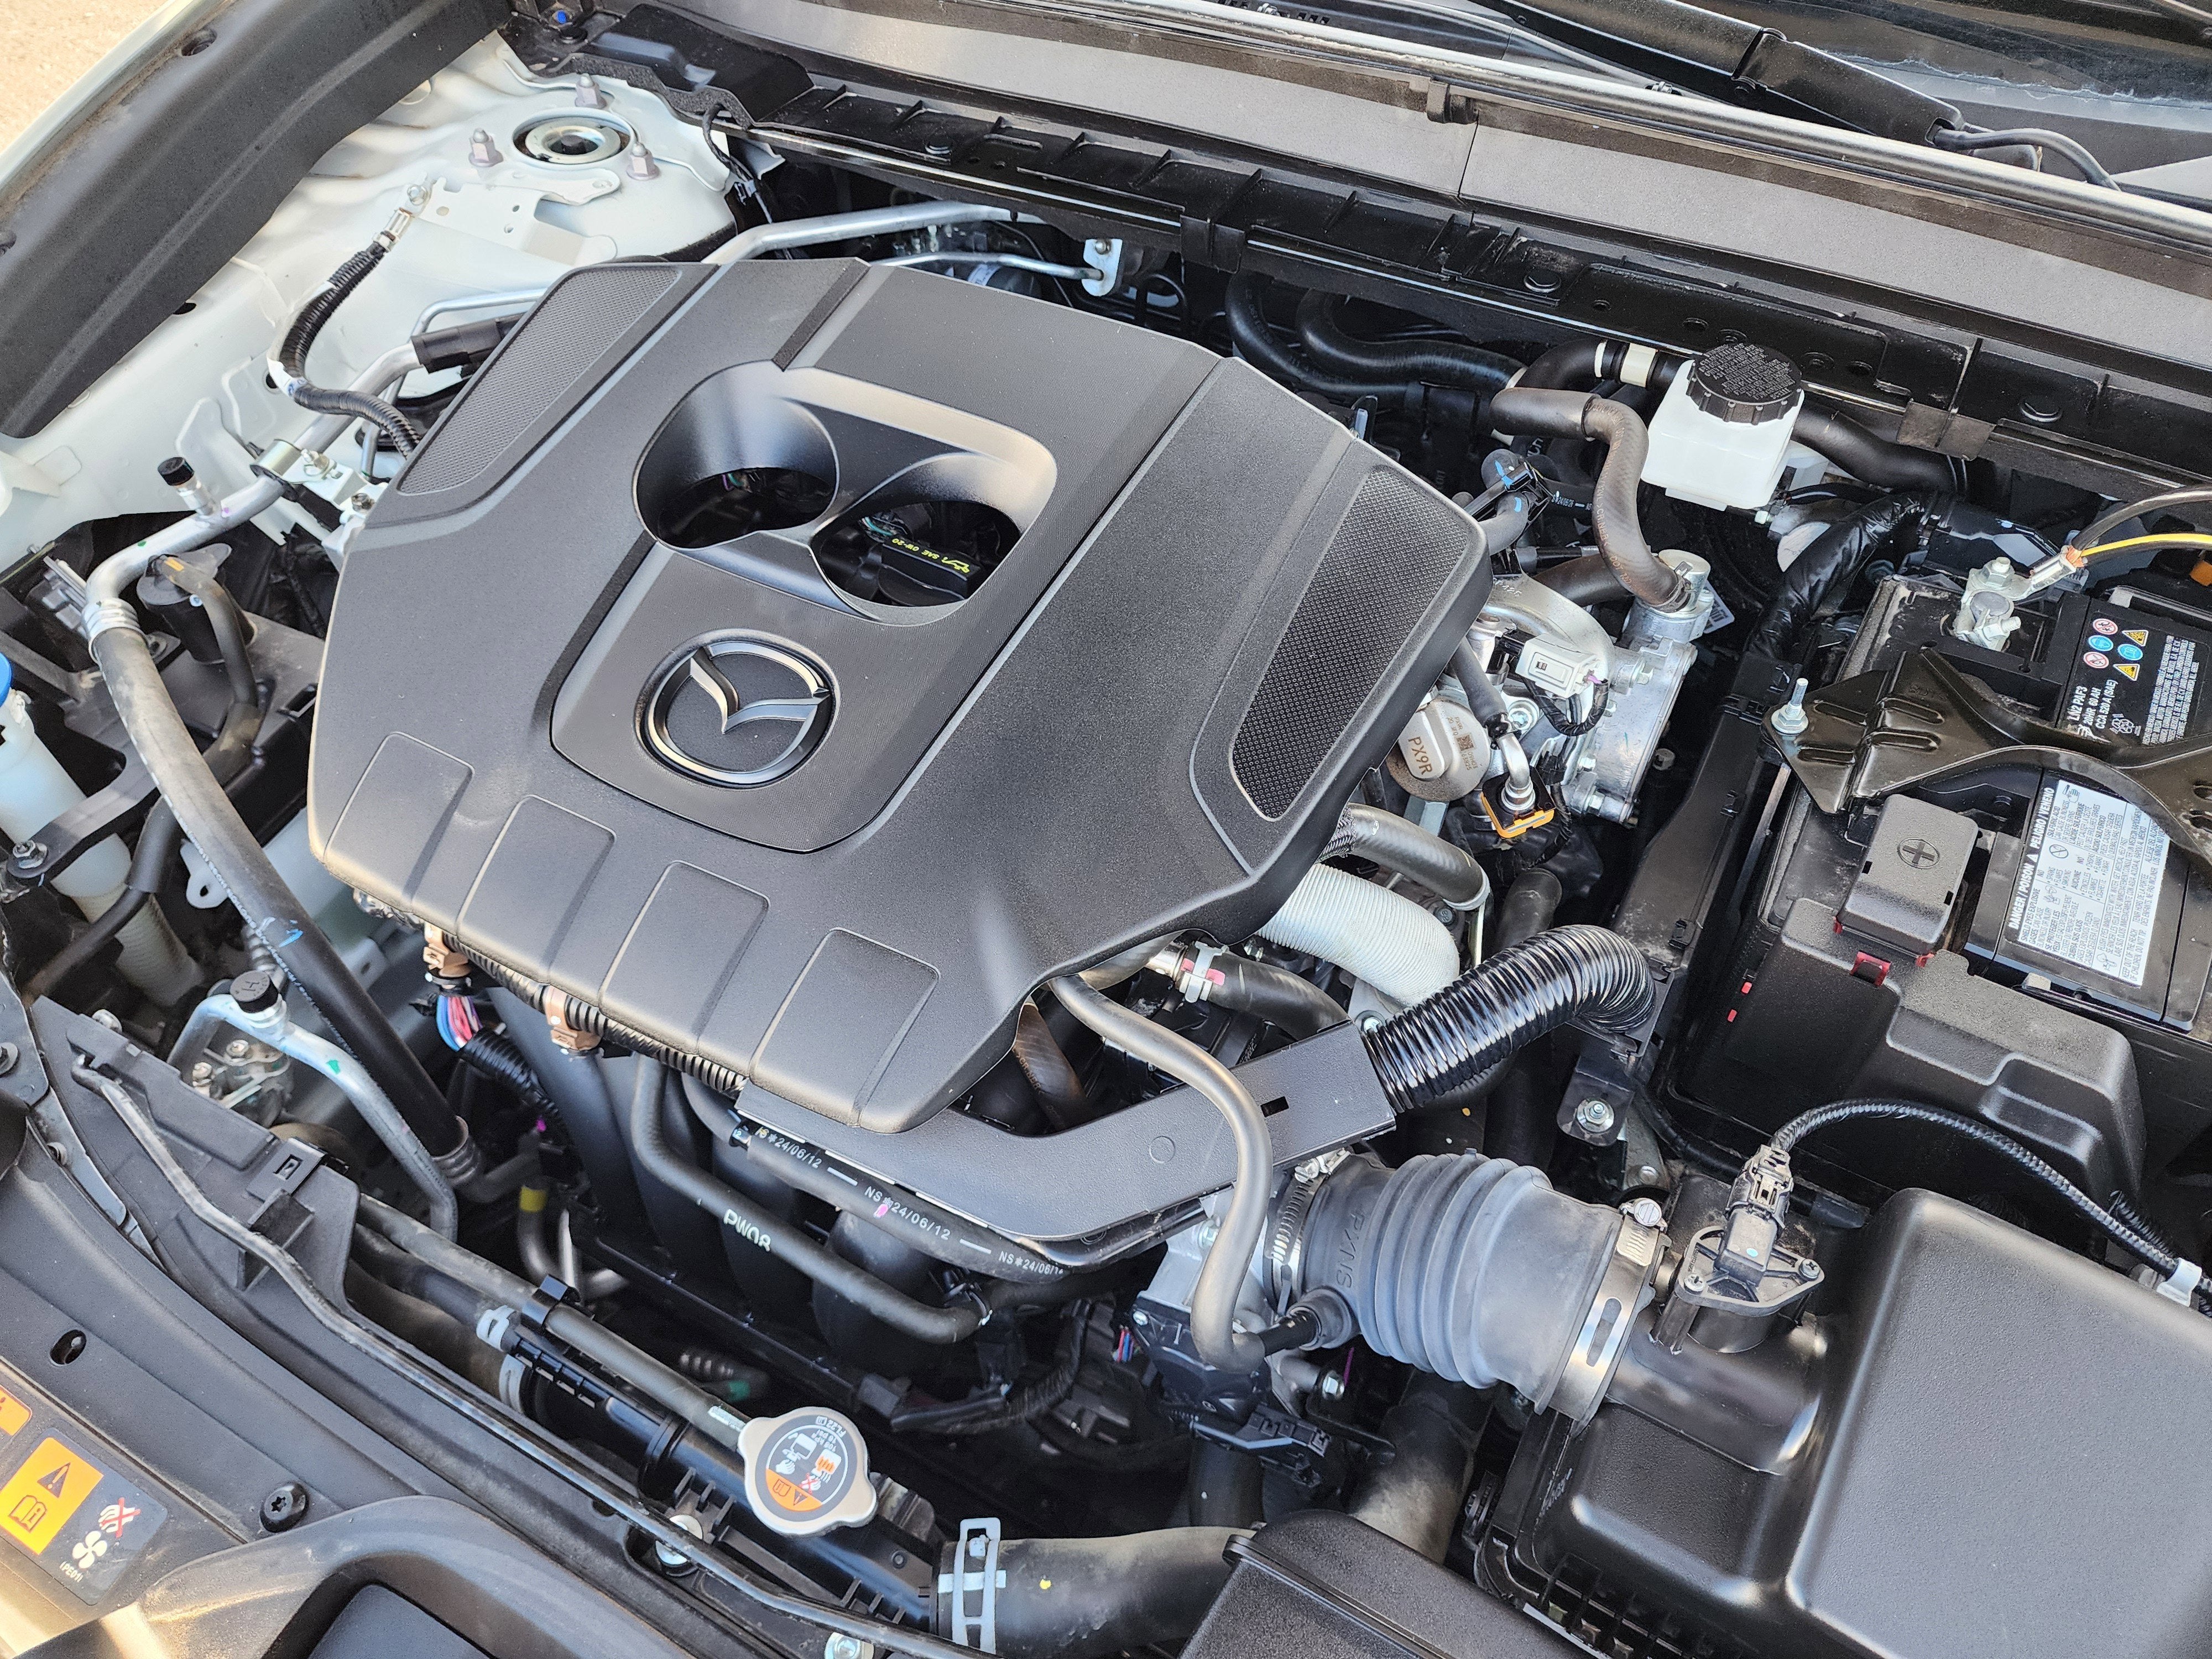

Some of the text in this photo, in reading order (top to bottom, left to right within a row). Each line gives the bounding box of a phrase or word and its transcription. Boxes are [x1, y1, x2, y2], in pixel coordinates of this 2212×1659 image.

[892, 538, 940, 559] SAE 0W-20
[1408, 737, 1433, 774] PX9R
[2073, 802, 2084, 827] SULFURIQUE
[2047, 816, 2057, 836] SULFURIC
[2008, 896, 2027, 929] DANGER
[2018, 863, 2035, 892] POISON
[2030, 818, 2046, 848] PELIGRO
[2038, 787, 2054, 815] VENENO
[2077, 855, 2084, 864] NO
[2037, 869, 2044, 877] NO
[2071, 870, 2080, 889] AUCUNE
[2021, 888, 2039, 941] SHIELD EYES EXPLOSIVE
[2068, 919, 2083, 958] CUBRA SUS OJOS
[825, 1419, 847, 1437] FL22
[59, 1561, 83, 1583] (PE01)
